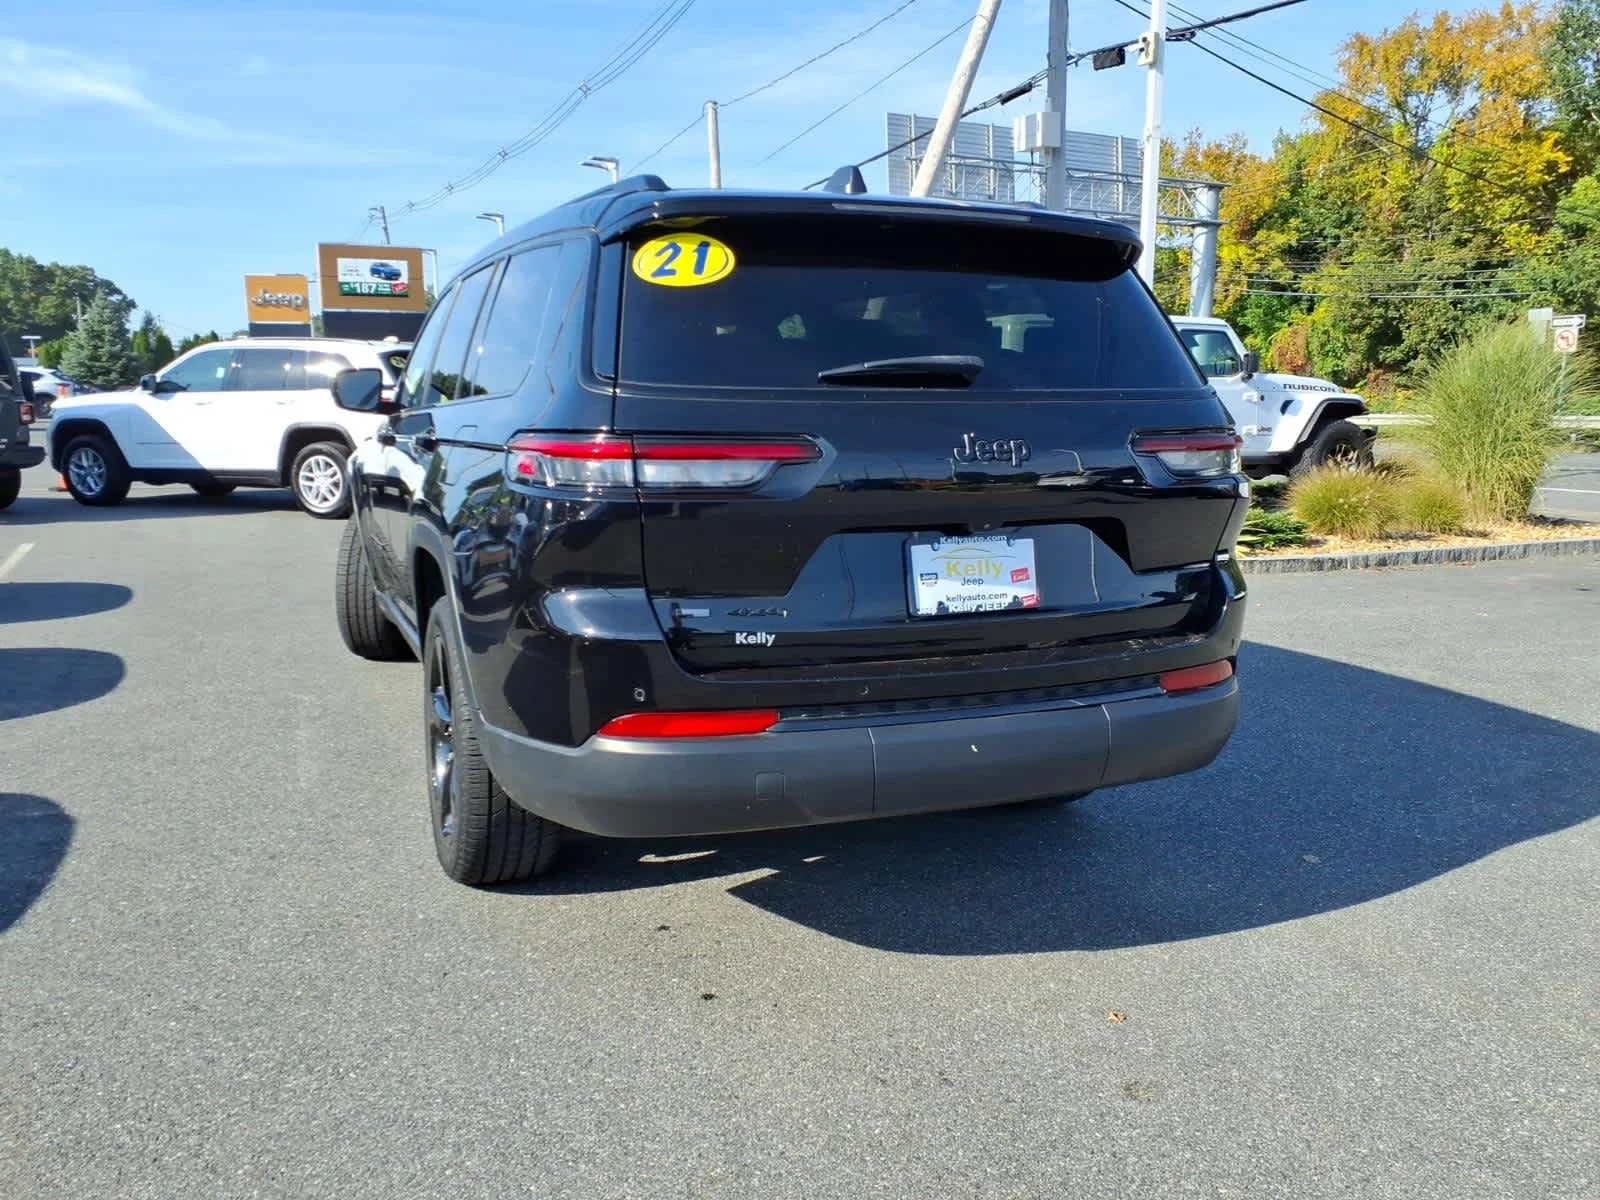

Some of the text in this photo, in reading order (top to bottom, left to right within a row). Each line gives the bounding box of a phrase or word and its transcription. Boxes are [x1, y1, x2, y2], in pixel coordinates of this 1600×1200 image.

[651, 240, 711, 279] 21
[251, 288, 304, 310] Jeep
[1283, 383, 1336, 393] RUBICON
[952, 431, 1032, 468] Jeep
[945, 560, 1004, 579] Kelly
[961, 577, 985, 586] Jeep
[946, 592, 1008, 603] kellyauto.com
[735, 631, 777, 647] Kelly
